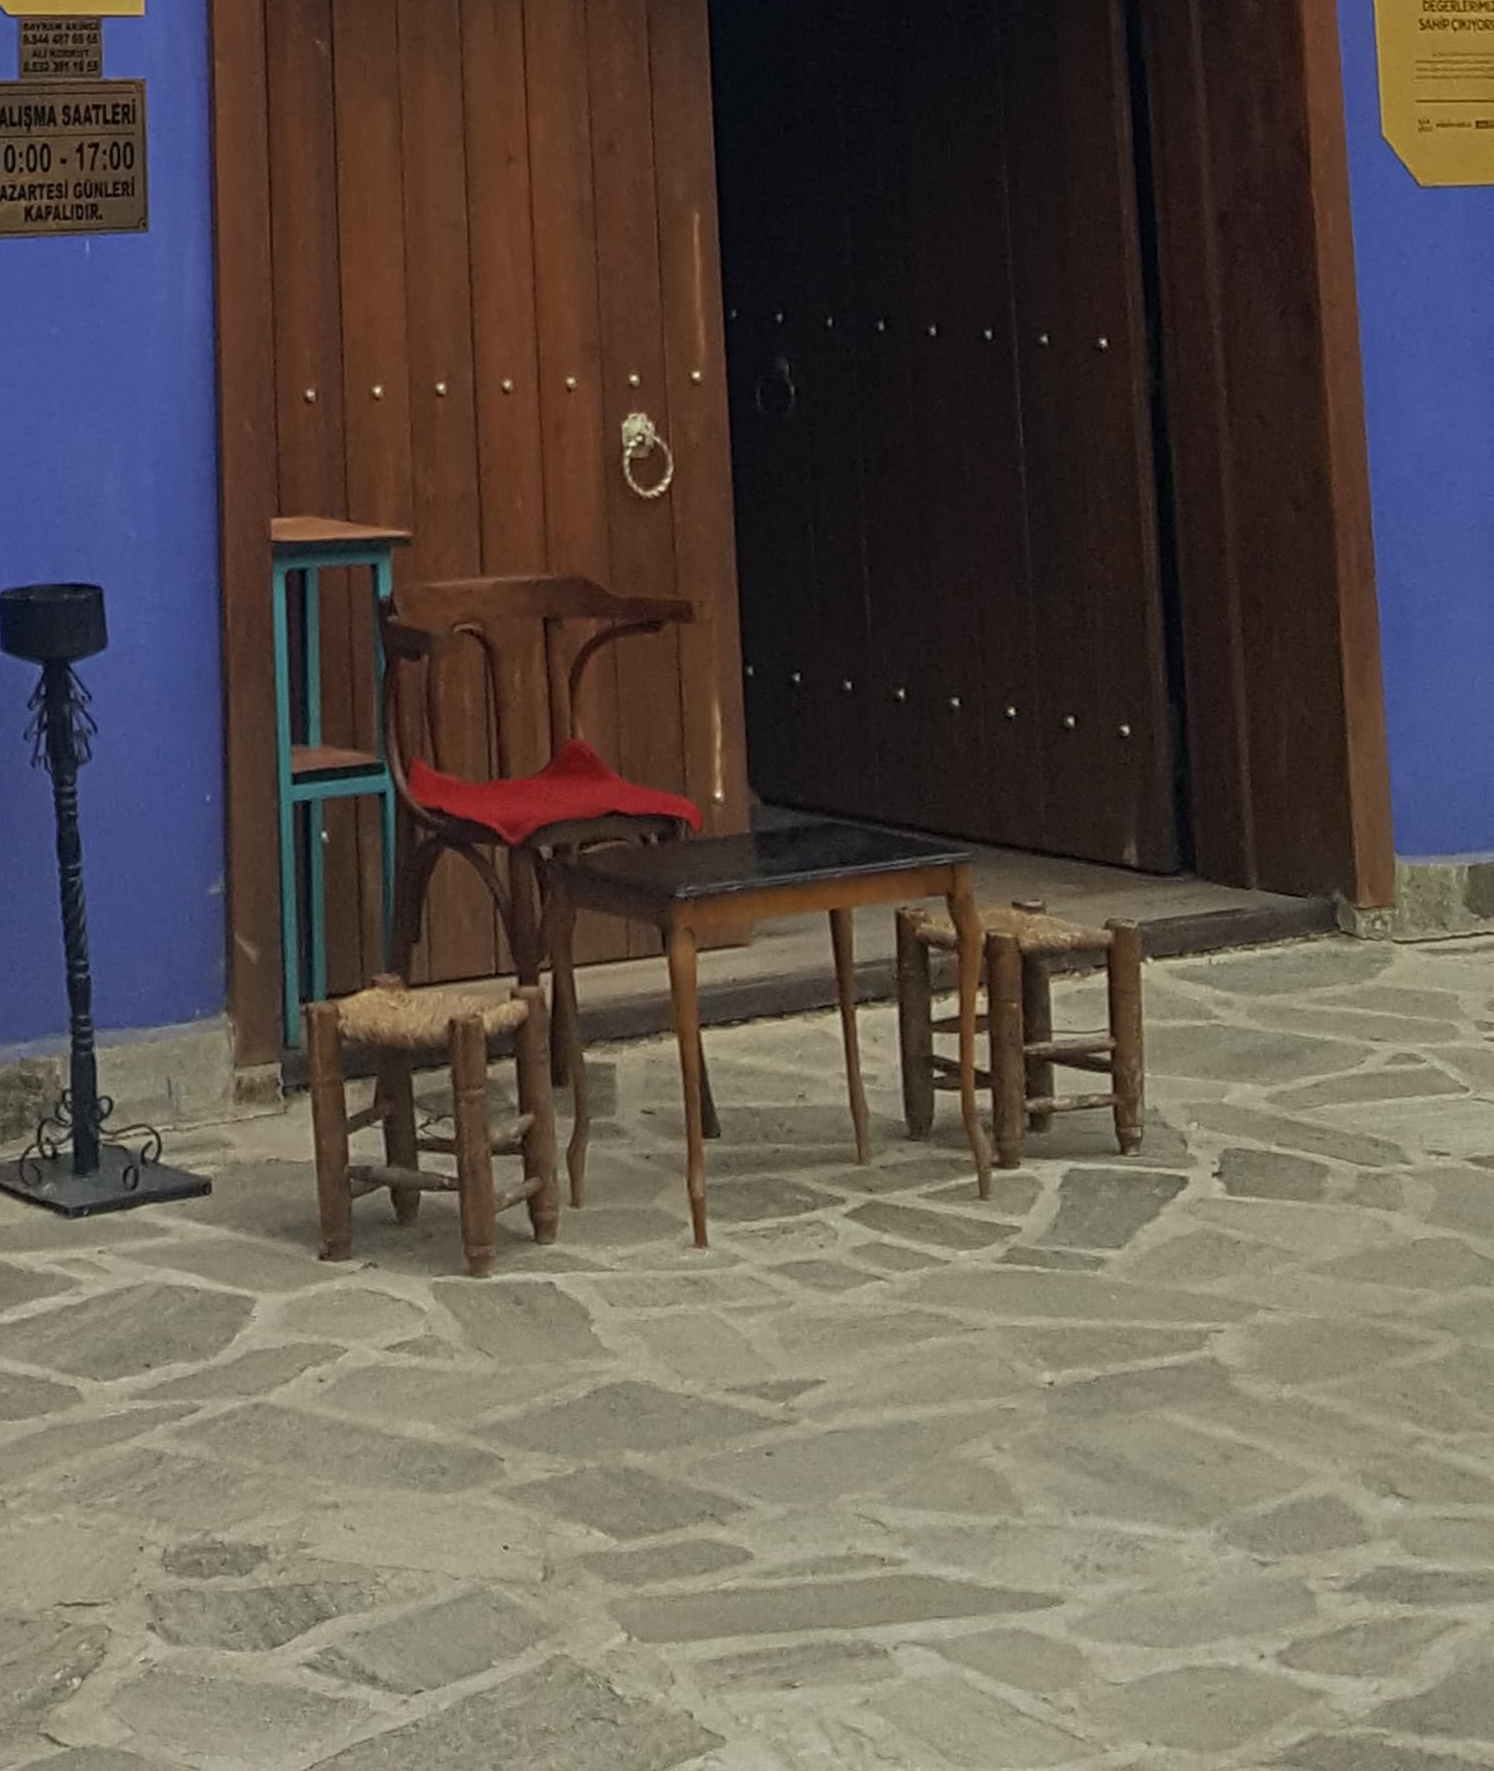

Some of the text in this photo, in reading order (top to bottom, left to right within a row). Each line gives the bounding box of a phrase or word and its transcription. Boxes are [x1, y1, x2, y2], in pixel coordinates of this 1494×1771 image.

[61, 99, 136, 126] SAATLERİ
[75, 141, 135, 172] 17:00
[73, 177, 136, 199] GÜNLERİ
[24, 203, 103, 223] KAPALIDIR.
